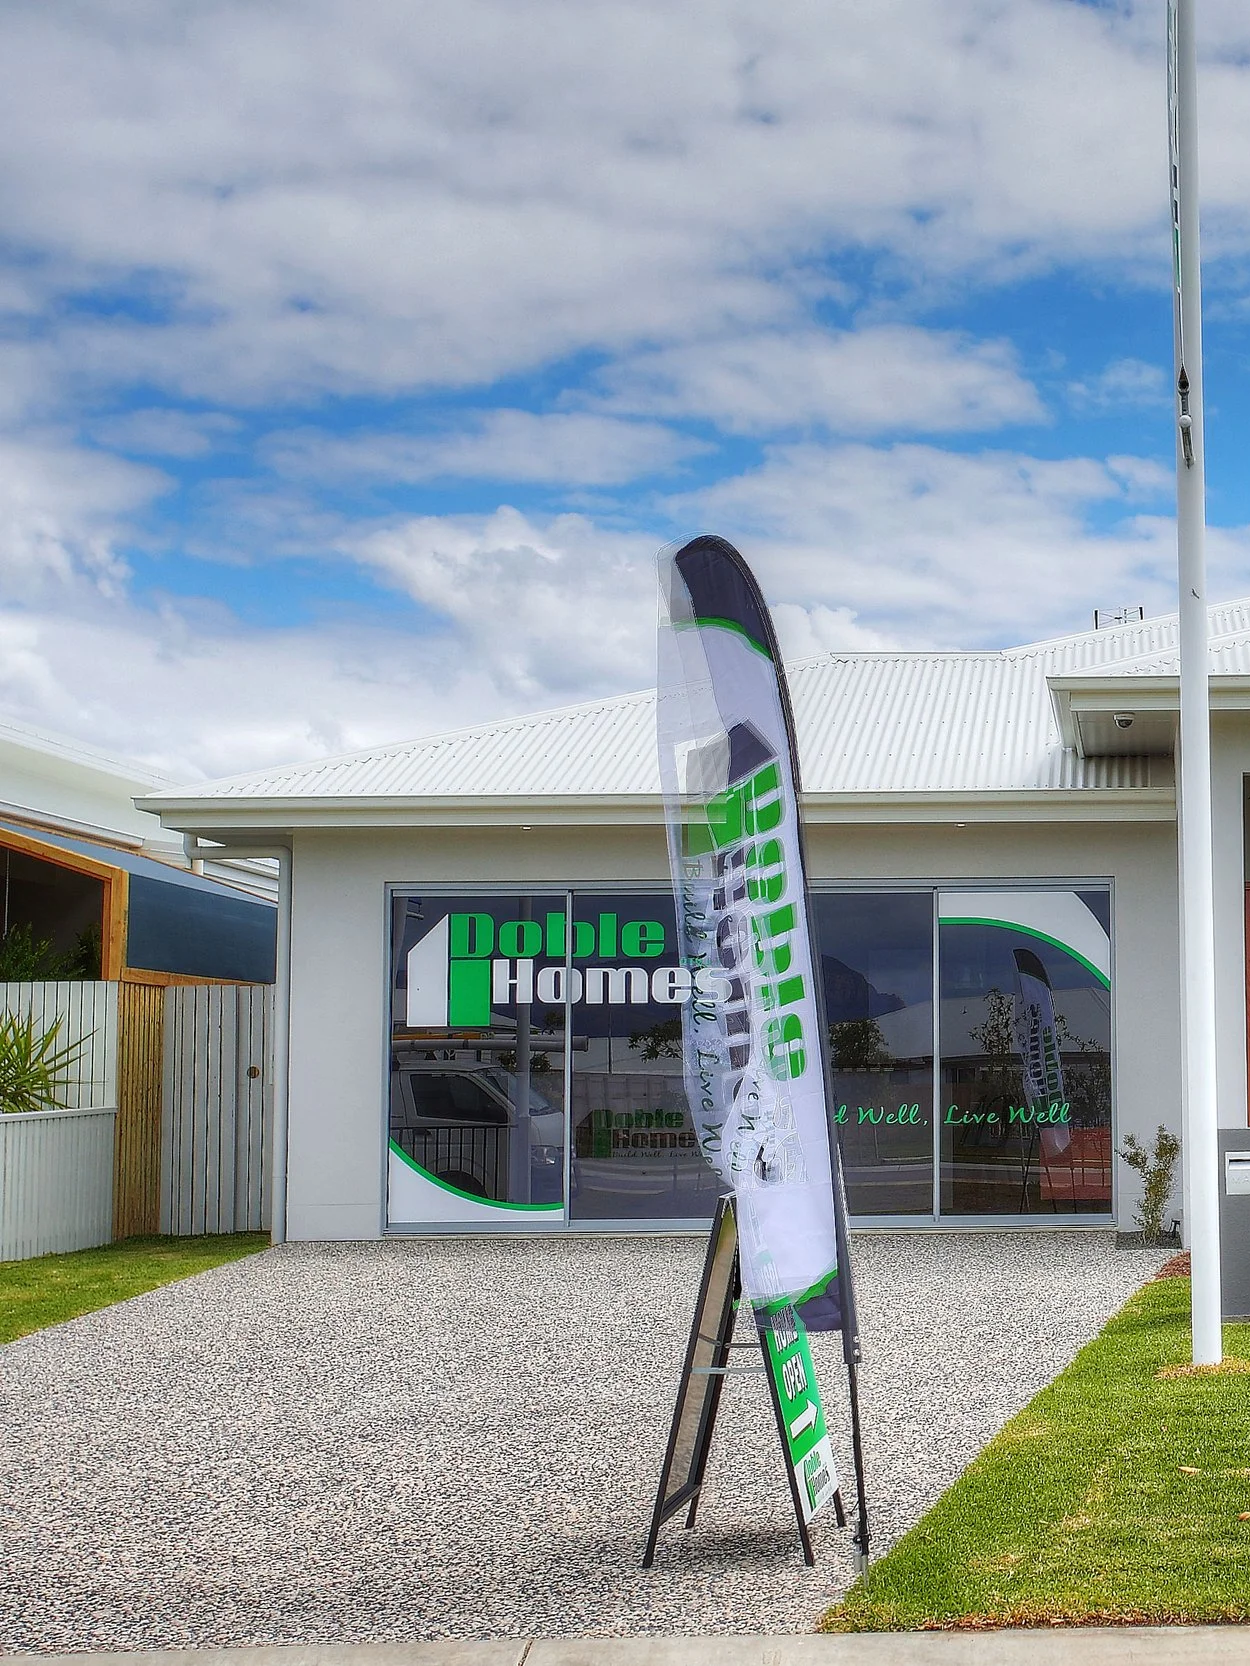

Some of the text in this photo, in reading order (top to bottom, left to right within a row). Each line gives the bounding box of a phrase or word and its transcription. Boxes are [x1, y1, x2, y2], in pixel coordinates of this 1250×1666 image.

[451, 912, 665, 958] Doble
[492, 958, 734, 1005] Homes
[593, 1109, 684, 1128] Doble
[943, 1104, 1000, 1125] Live
[1009, 1102, 1072, 1124] Well
[612, 1128, 700, 1149] Home
[782, 1352, 808, 1402] OPEN
